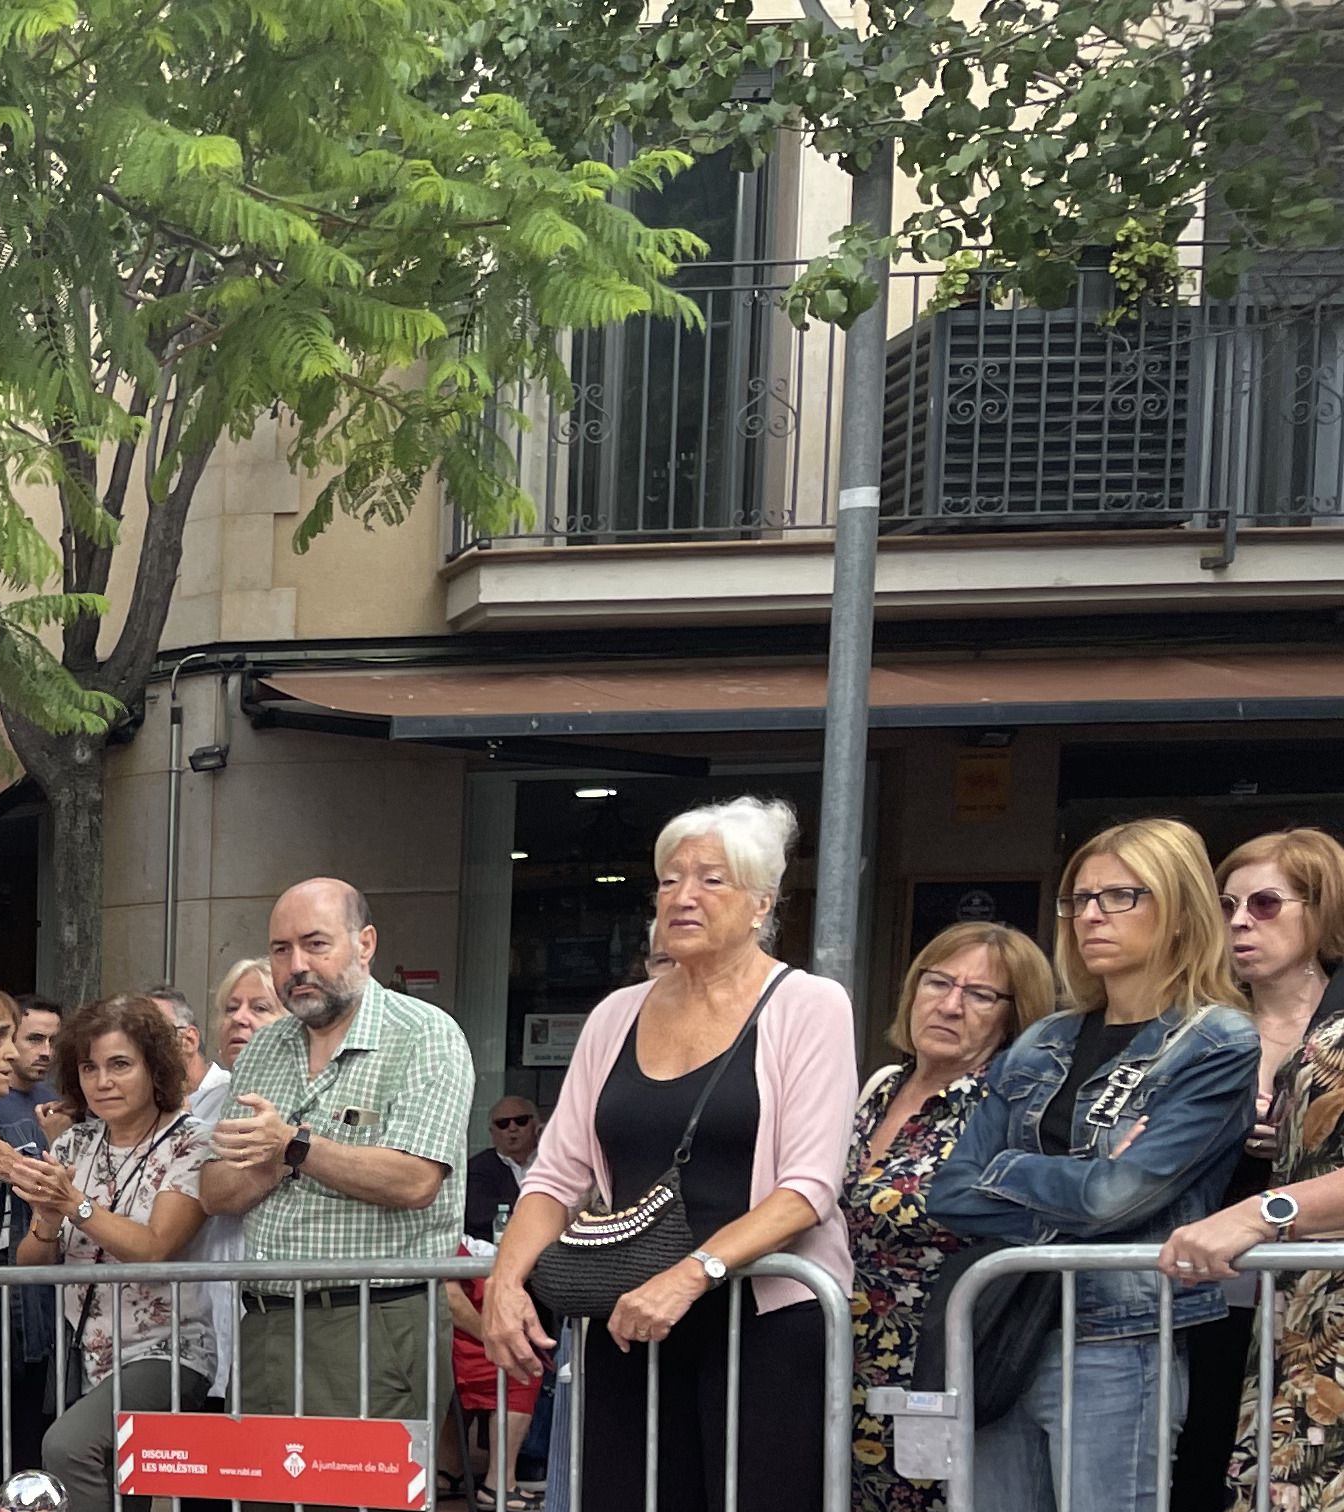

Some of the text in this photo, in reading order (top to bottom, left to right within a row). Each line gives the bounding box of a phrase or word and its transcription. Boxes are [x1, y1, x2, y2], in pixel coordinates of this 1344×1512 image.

[141, 1449, 189, 1460] DISCULPEU
[141, 1462, 158, 1473] LES
[311, 1459, 364, 1472] Ajuntament
[364, 1462, 377, 1473] de
